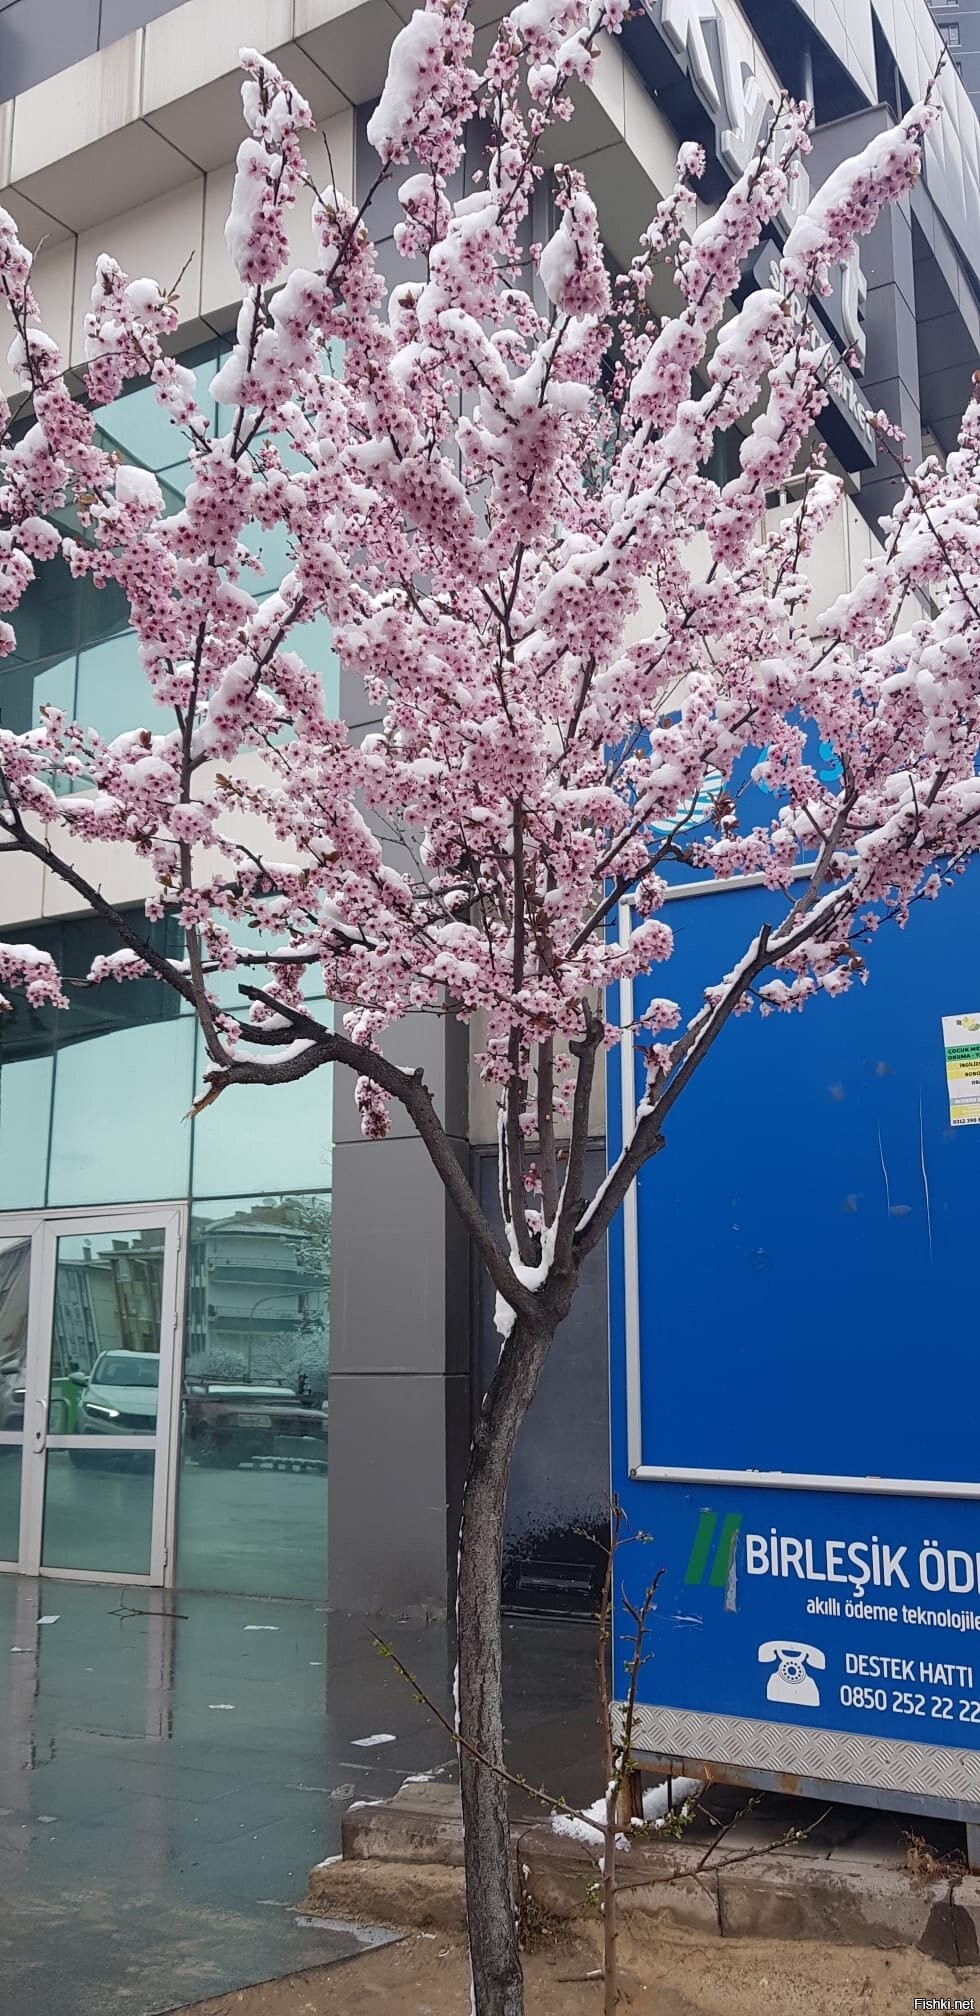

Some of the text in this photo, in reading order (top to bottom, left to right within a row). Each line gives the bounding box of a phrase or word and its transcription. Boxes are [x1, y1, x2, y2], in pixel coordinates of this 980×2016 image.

[746, 1527, 910, 1597] BİRLEŞİK
[806, 1596, 841, 1617] akıllı
[844, 1600, 898, 1622] ödeme
[845, 1652, 974, 1688] DESTEK HATTI
[839, 1684, 980, 1723] 0850 252 22 22
